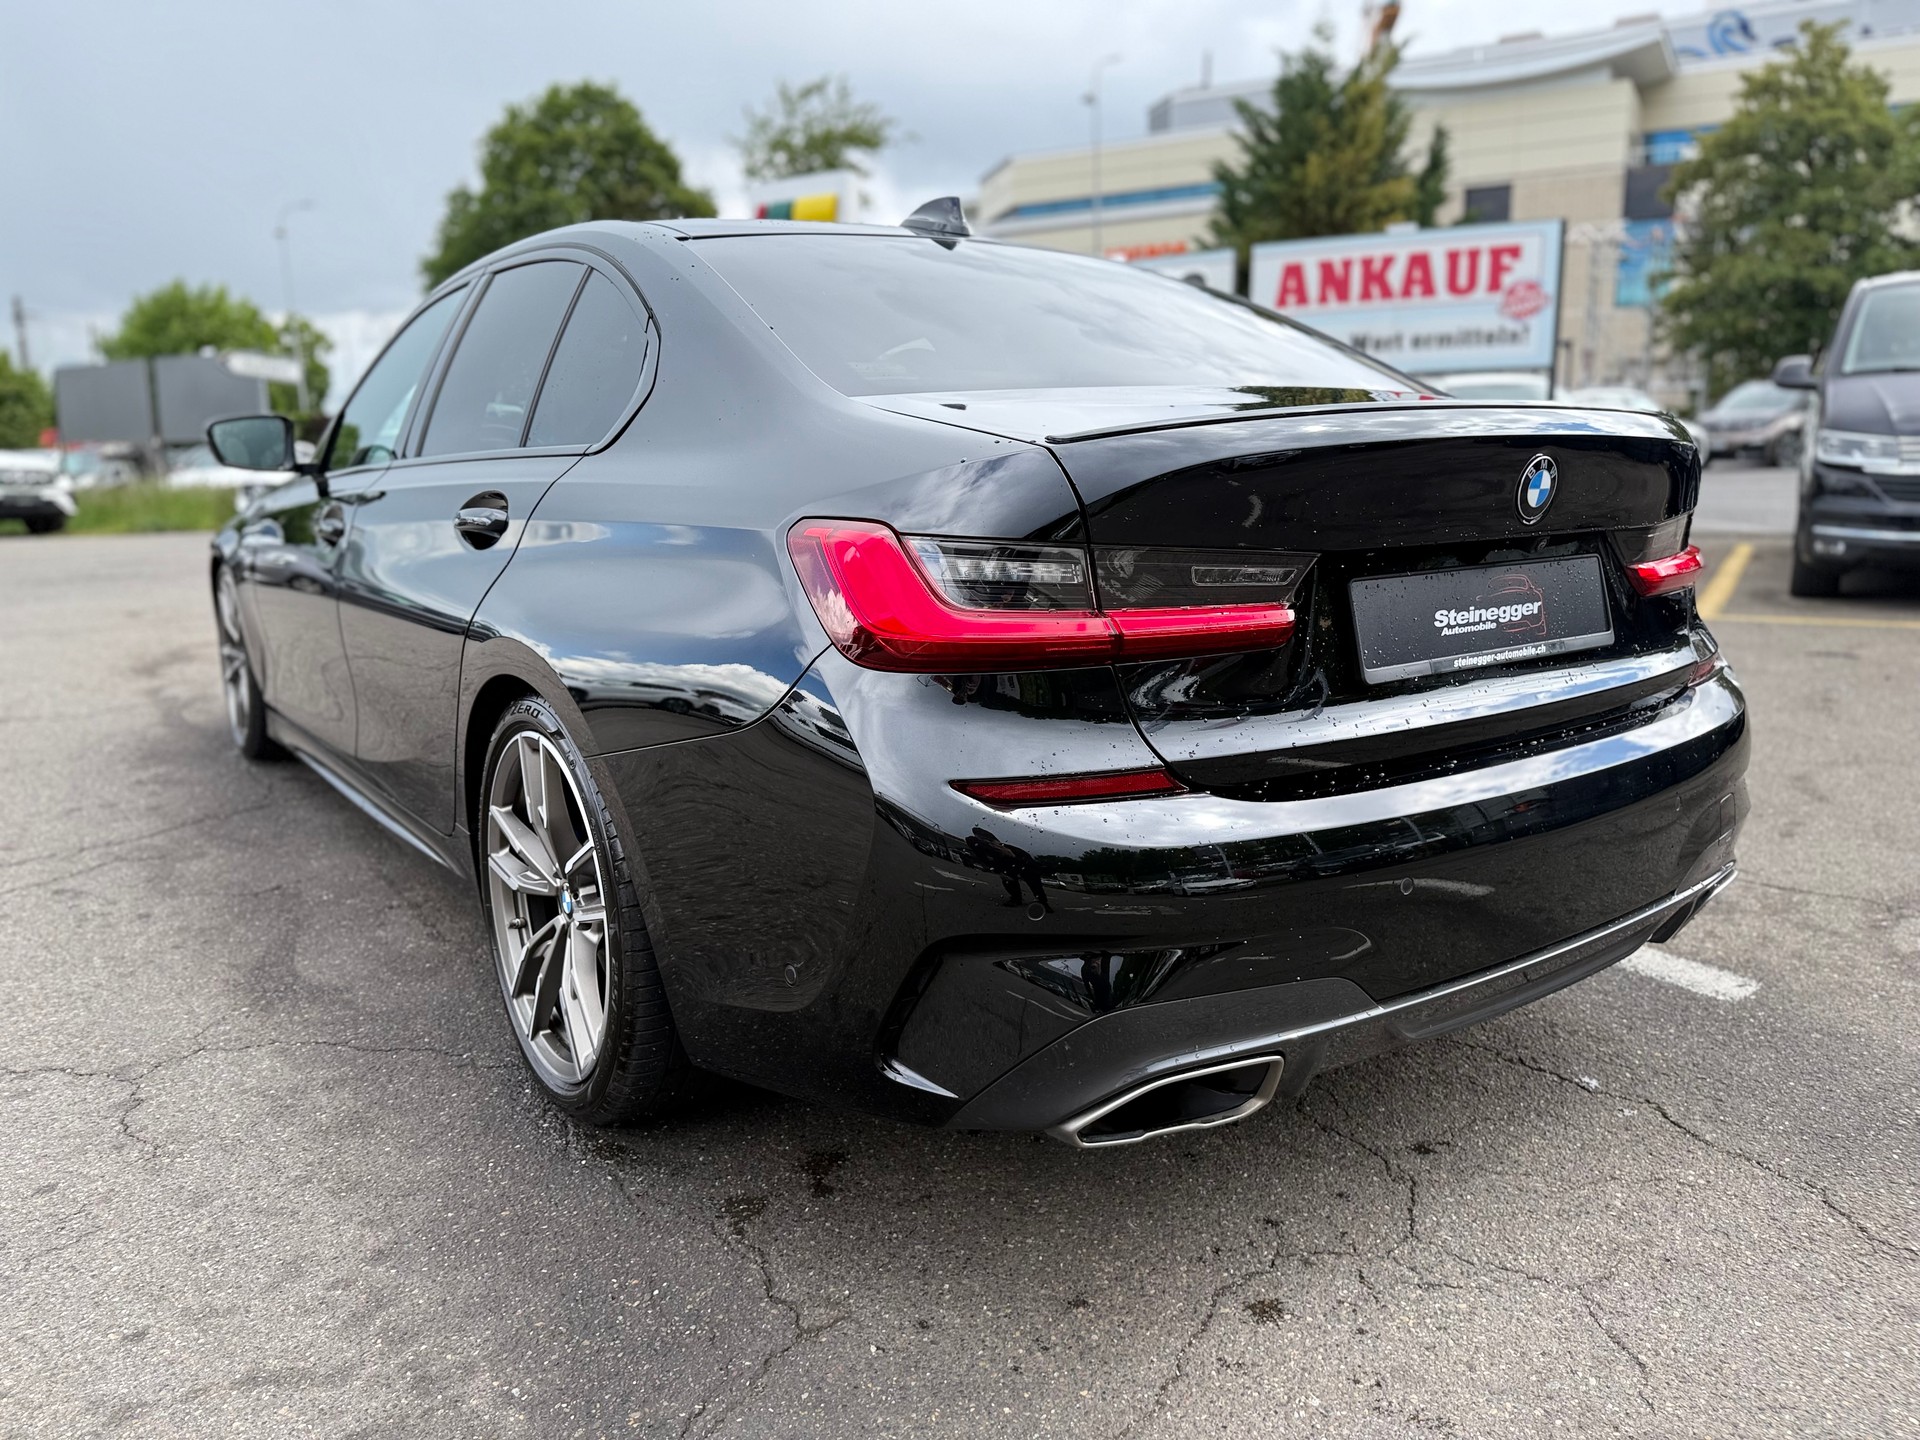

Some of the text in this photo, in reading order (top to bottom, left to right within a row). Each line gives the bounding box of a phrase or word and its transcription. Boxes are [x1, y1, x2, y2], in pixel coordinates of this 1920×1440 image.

[1275, 245, 1523, 307] ANKAUF
[1527, 459, 1557, 479] BMW
[1433, 601, 1542, 628] Steinegger
[1440, 622, 1497, 637] Automobile
[1453, 645, 1546, 668] steinegger-automobile.ch
